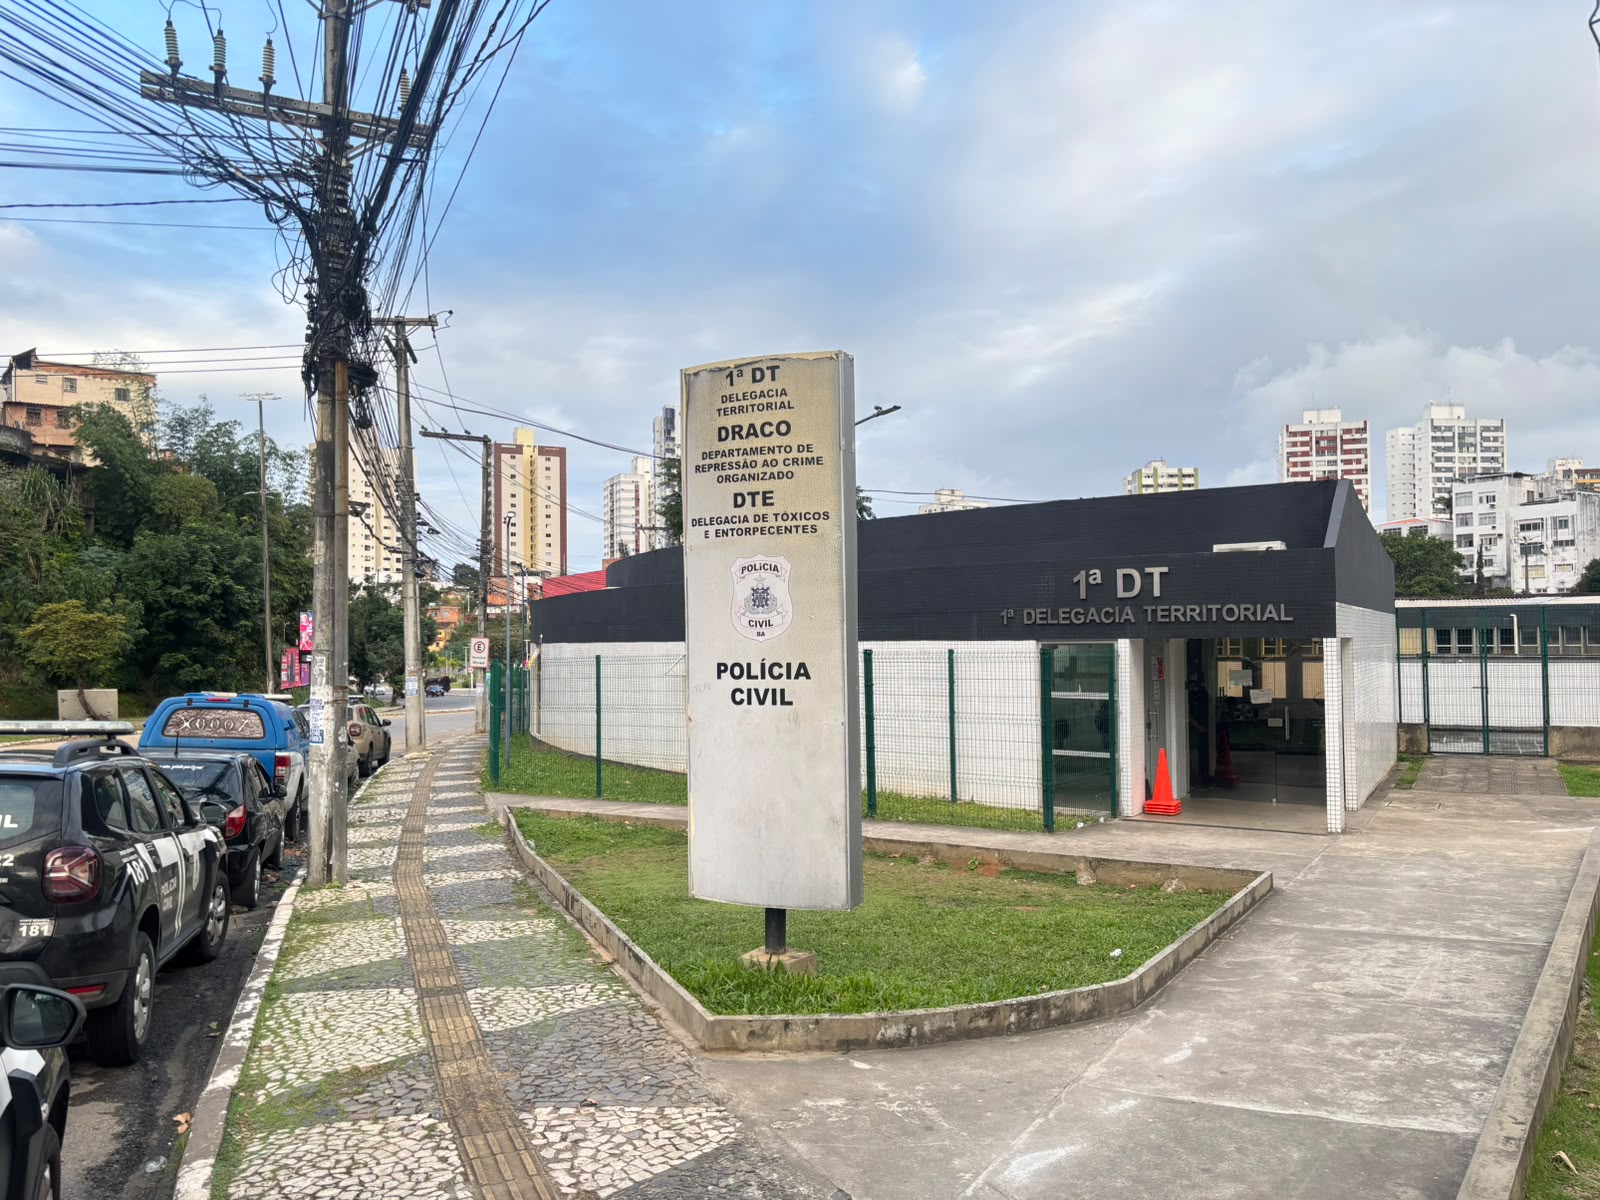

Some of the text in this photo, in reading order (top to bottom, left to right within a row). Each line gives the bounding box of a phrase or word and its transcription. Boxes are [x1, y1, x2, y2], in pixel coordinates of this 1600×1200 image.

[725, 365, 780, 387] 1ª DT
[721, 388, 788, 404] DELEGACIA
[716, 400, 794, 417] TERRITORIAL
[717, 420, 792, 442] DRACO
[701, 443, 814, 461] DEPARTAMENTO DE
[694, 456, 824, 474] REPRESSÃO AO CRIME
[716, 470, 794, 484] ORGANIZADO
[733, 490, 775, 509] DTE
[691, 510, 830, 527] DELEGACIA DE TÓXICOS
[704, 524, 818, 539] E ENTORPECENTES
[1072, 566, 1169, 600] 1ª DT
[1000, 603, 1294, 625] 1ª DELEGACIA TERRITORIAL
[748, 619, 774, 628] CIVIL
[477, 643, 482, 652] E
[716, 658, 812, 680] POLÍCIA
[730, 688, 794, 706] CIVIL
[126, 858, 149, 886] 181
[19, 925, 50, 937] 181
